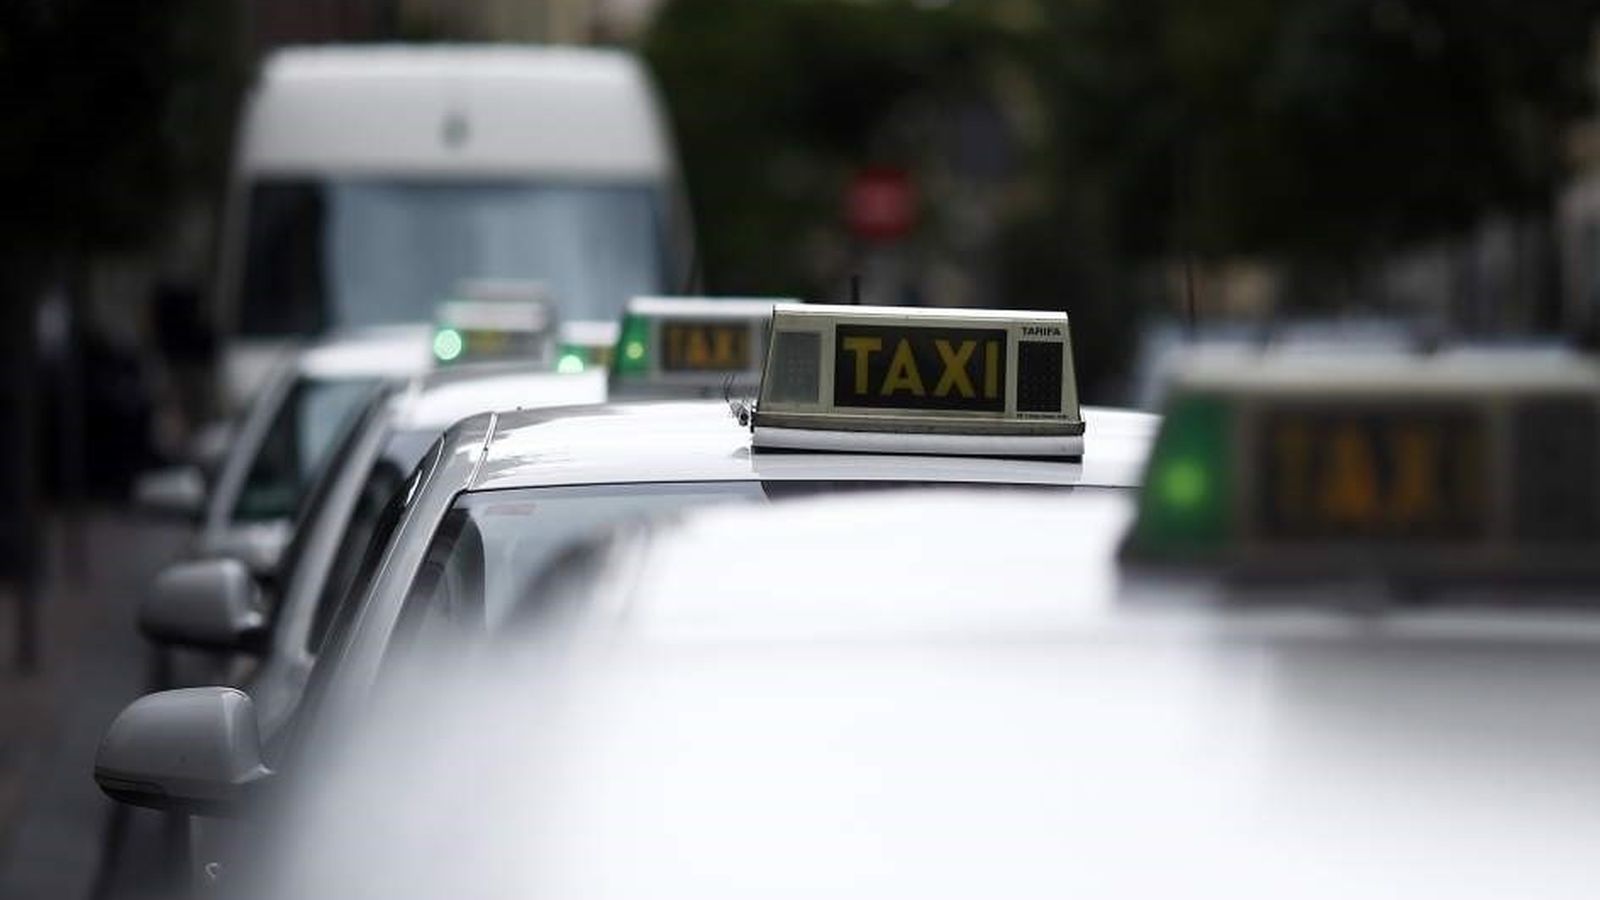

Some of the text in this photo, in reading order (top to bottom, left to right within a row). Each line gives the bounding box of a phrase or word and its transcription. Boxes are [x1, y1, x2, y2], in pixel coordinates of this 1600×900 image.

[666, 325, 750, 369] TAXI
[1022, 327, 1062, 337] TARIFA
[843, 336, 999, 399] TAXI
